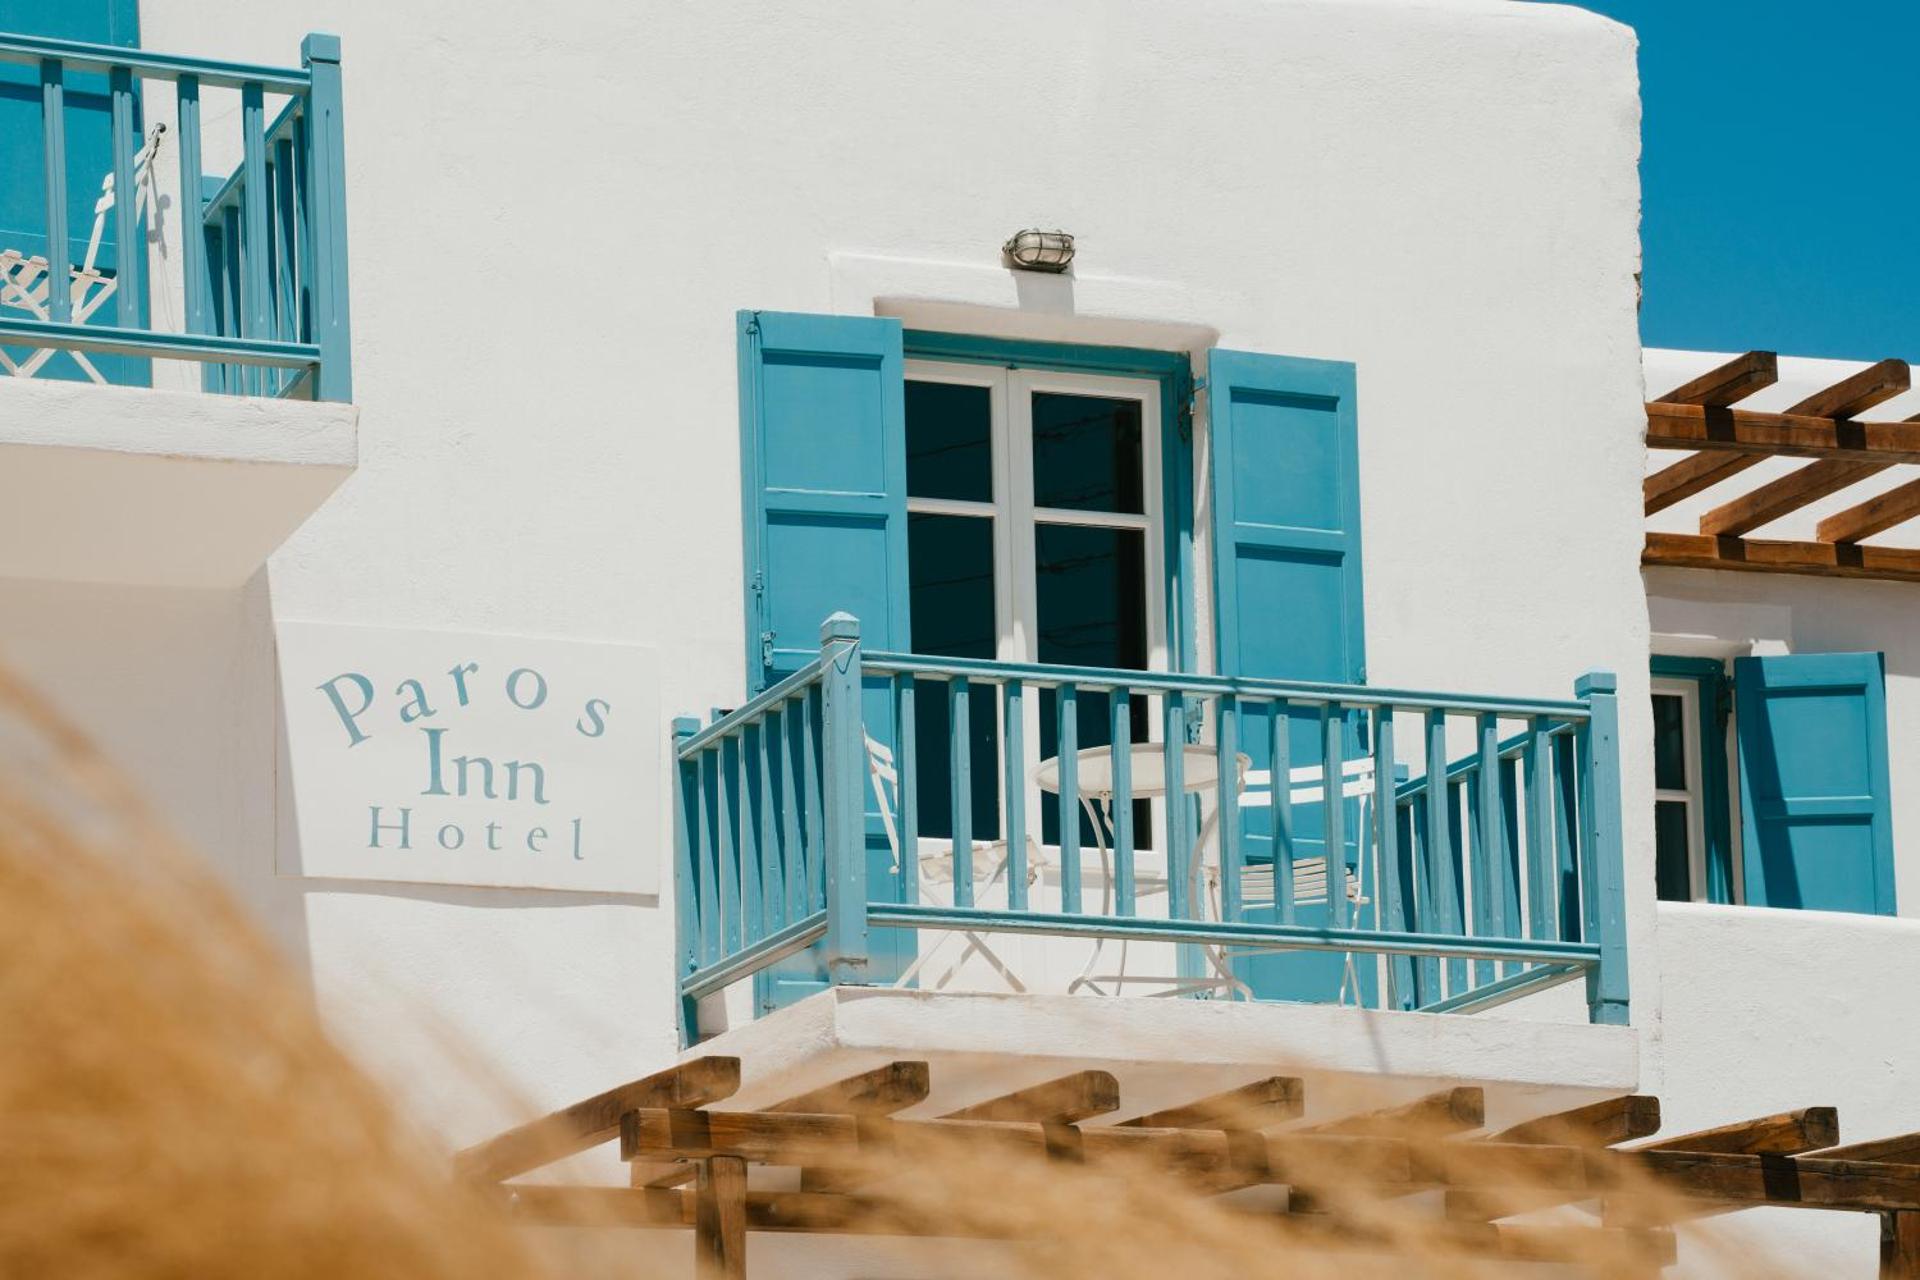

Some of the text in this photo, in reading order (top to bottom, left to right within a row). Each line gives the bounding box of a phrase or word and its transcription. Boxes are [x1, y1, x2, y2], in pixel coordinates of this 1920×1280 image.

[315, 661, 612, 747] Paros
[420, 727, 551, 805] Inn
[367, 805, 585, 861] Hotel
